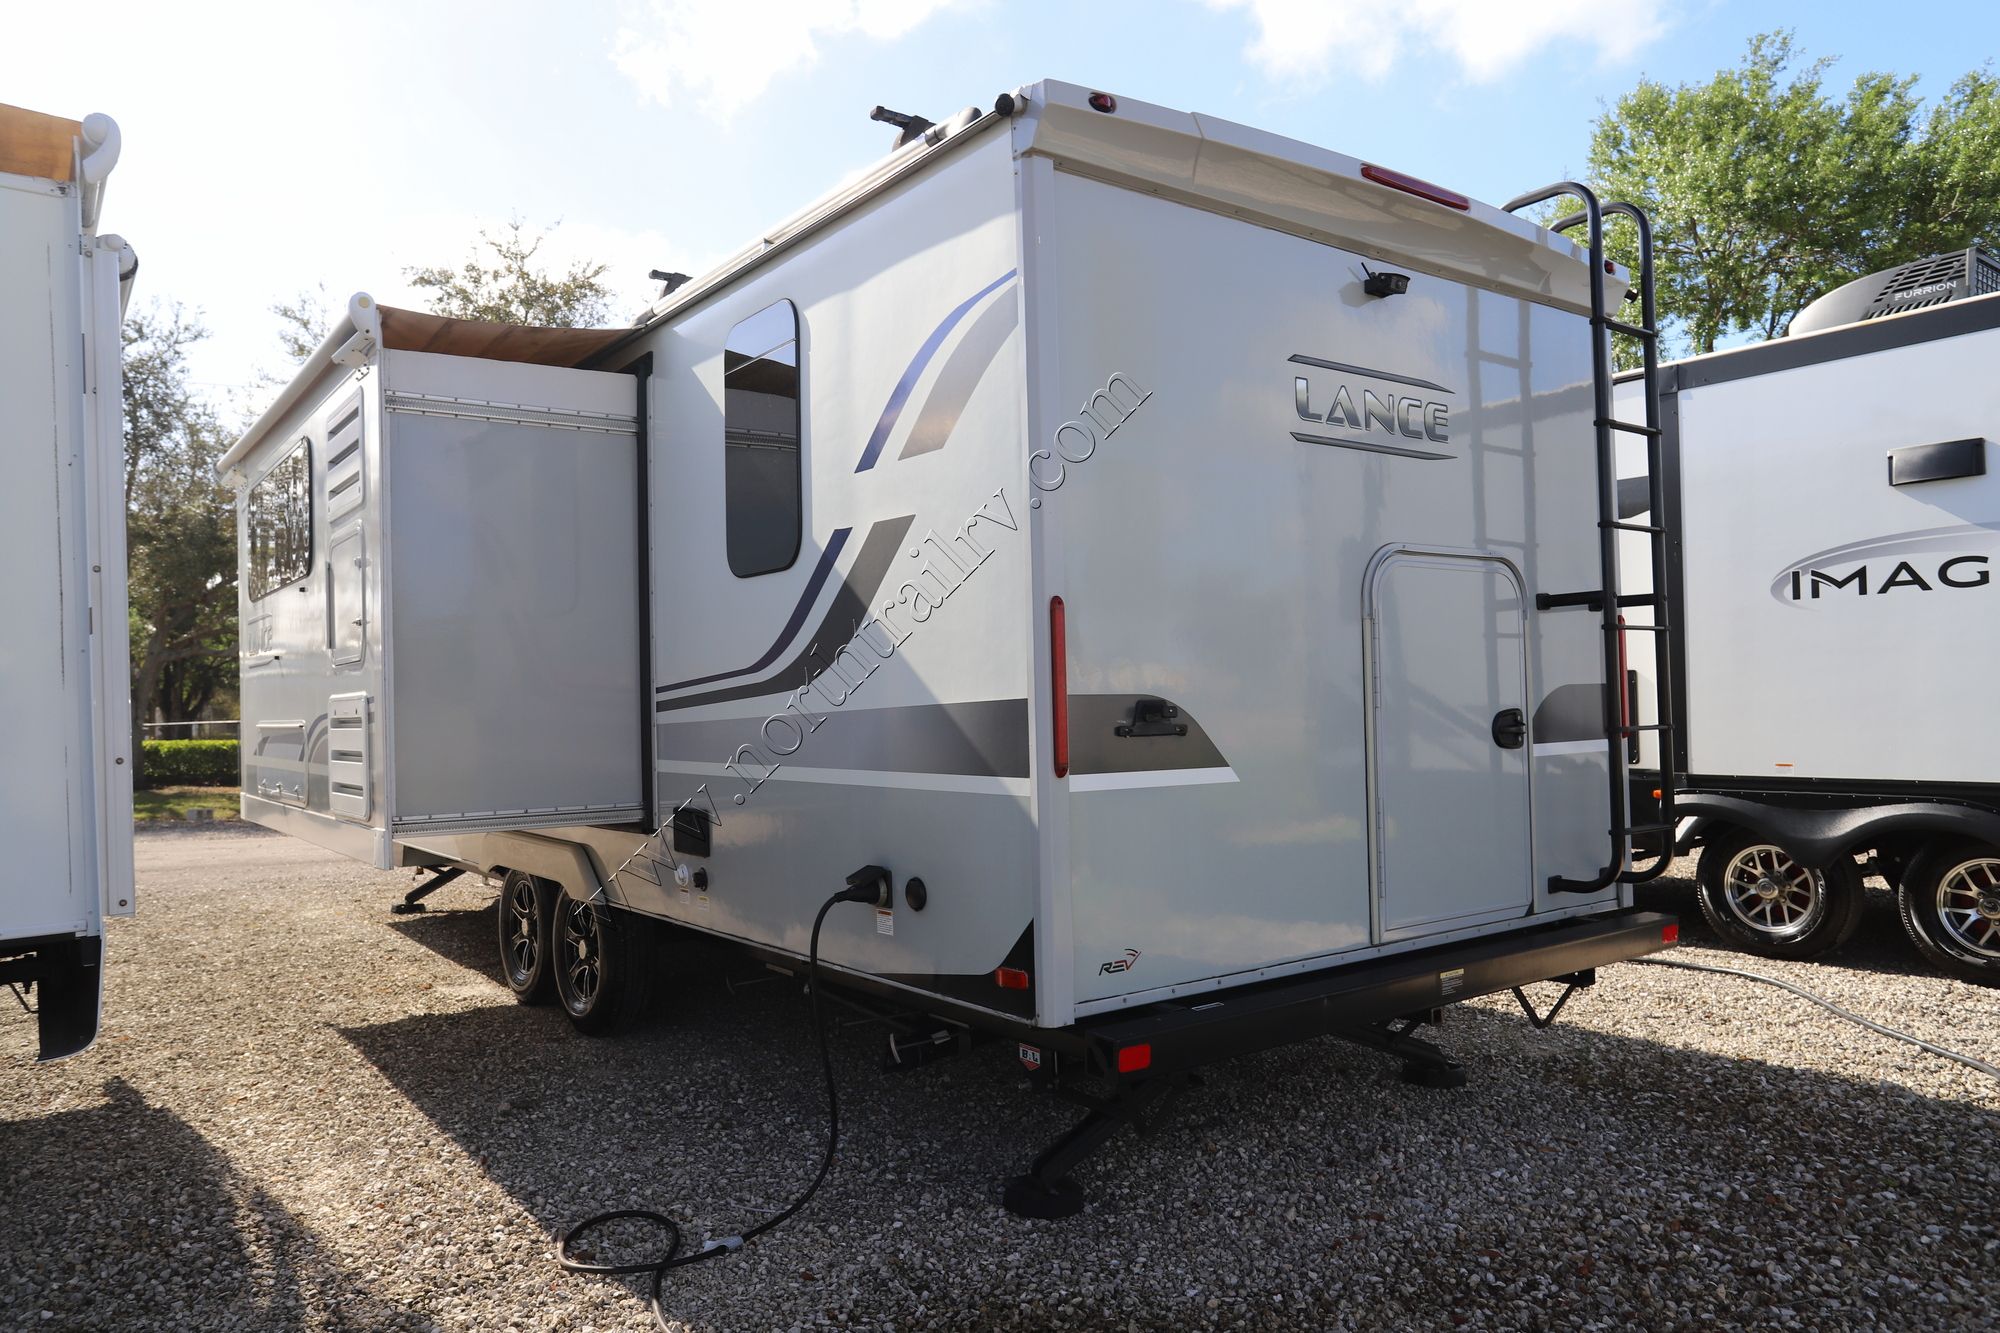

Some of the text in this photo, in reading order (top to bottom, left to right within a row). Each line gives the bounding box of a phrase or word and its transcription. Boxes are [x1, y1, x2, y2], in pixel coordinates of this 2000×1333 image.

[1894, 280, 1957, 301] FURRION
[1294, 376, 1449, 444] LANCE
[1791, 555, 1990, 601] IMAG
[1099, 951, 1141, 976] REV
